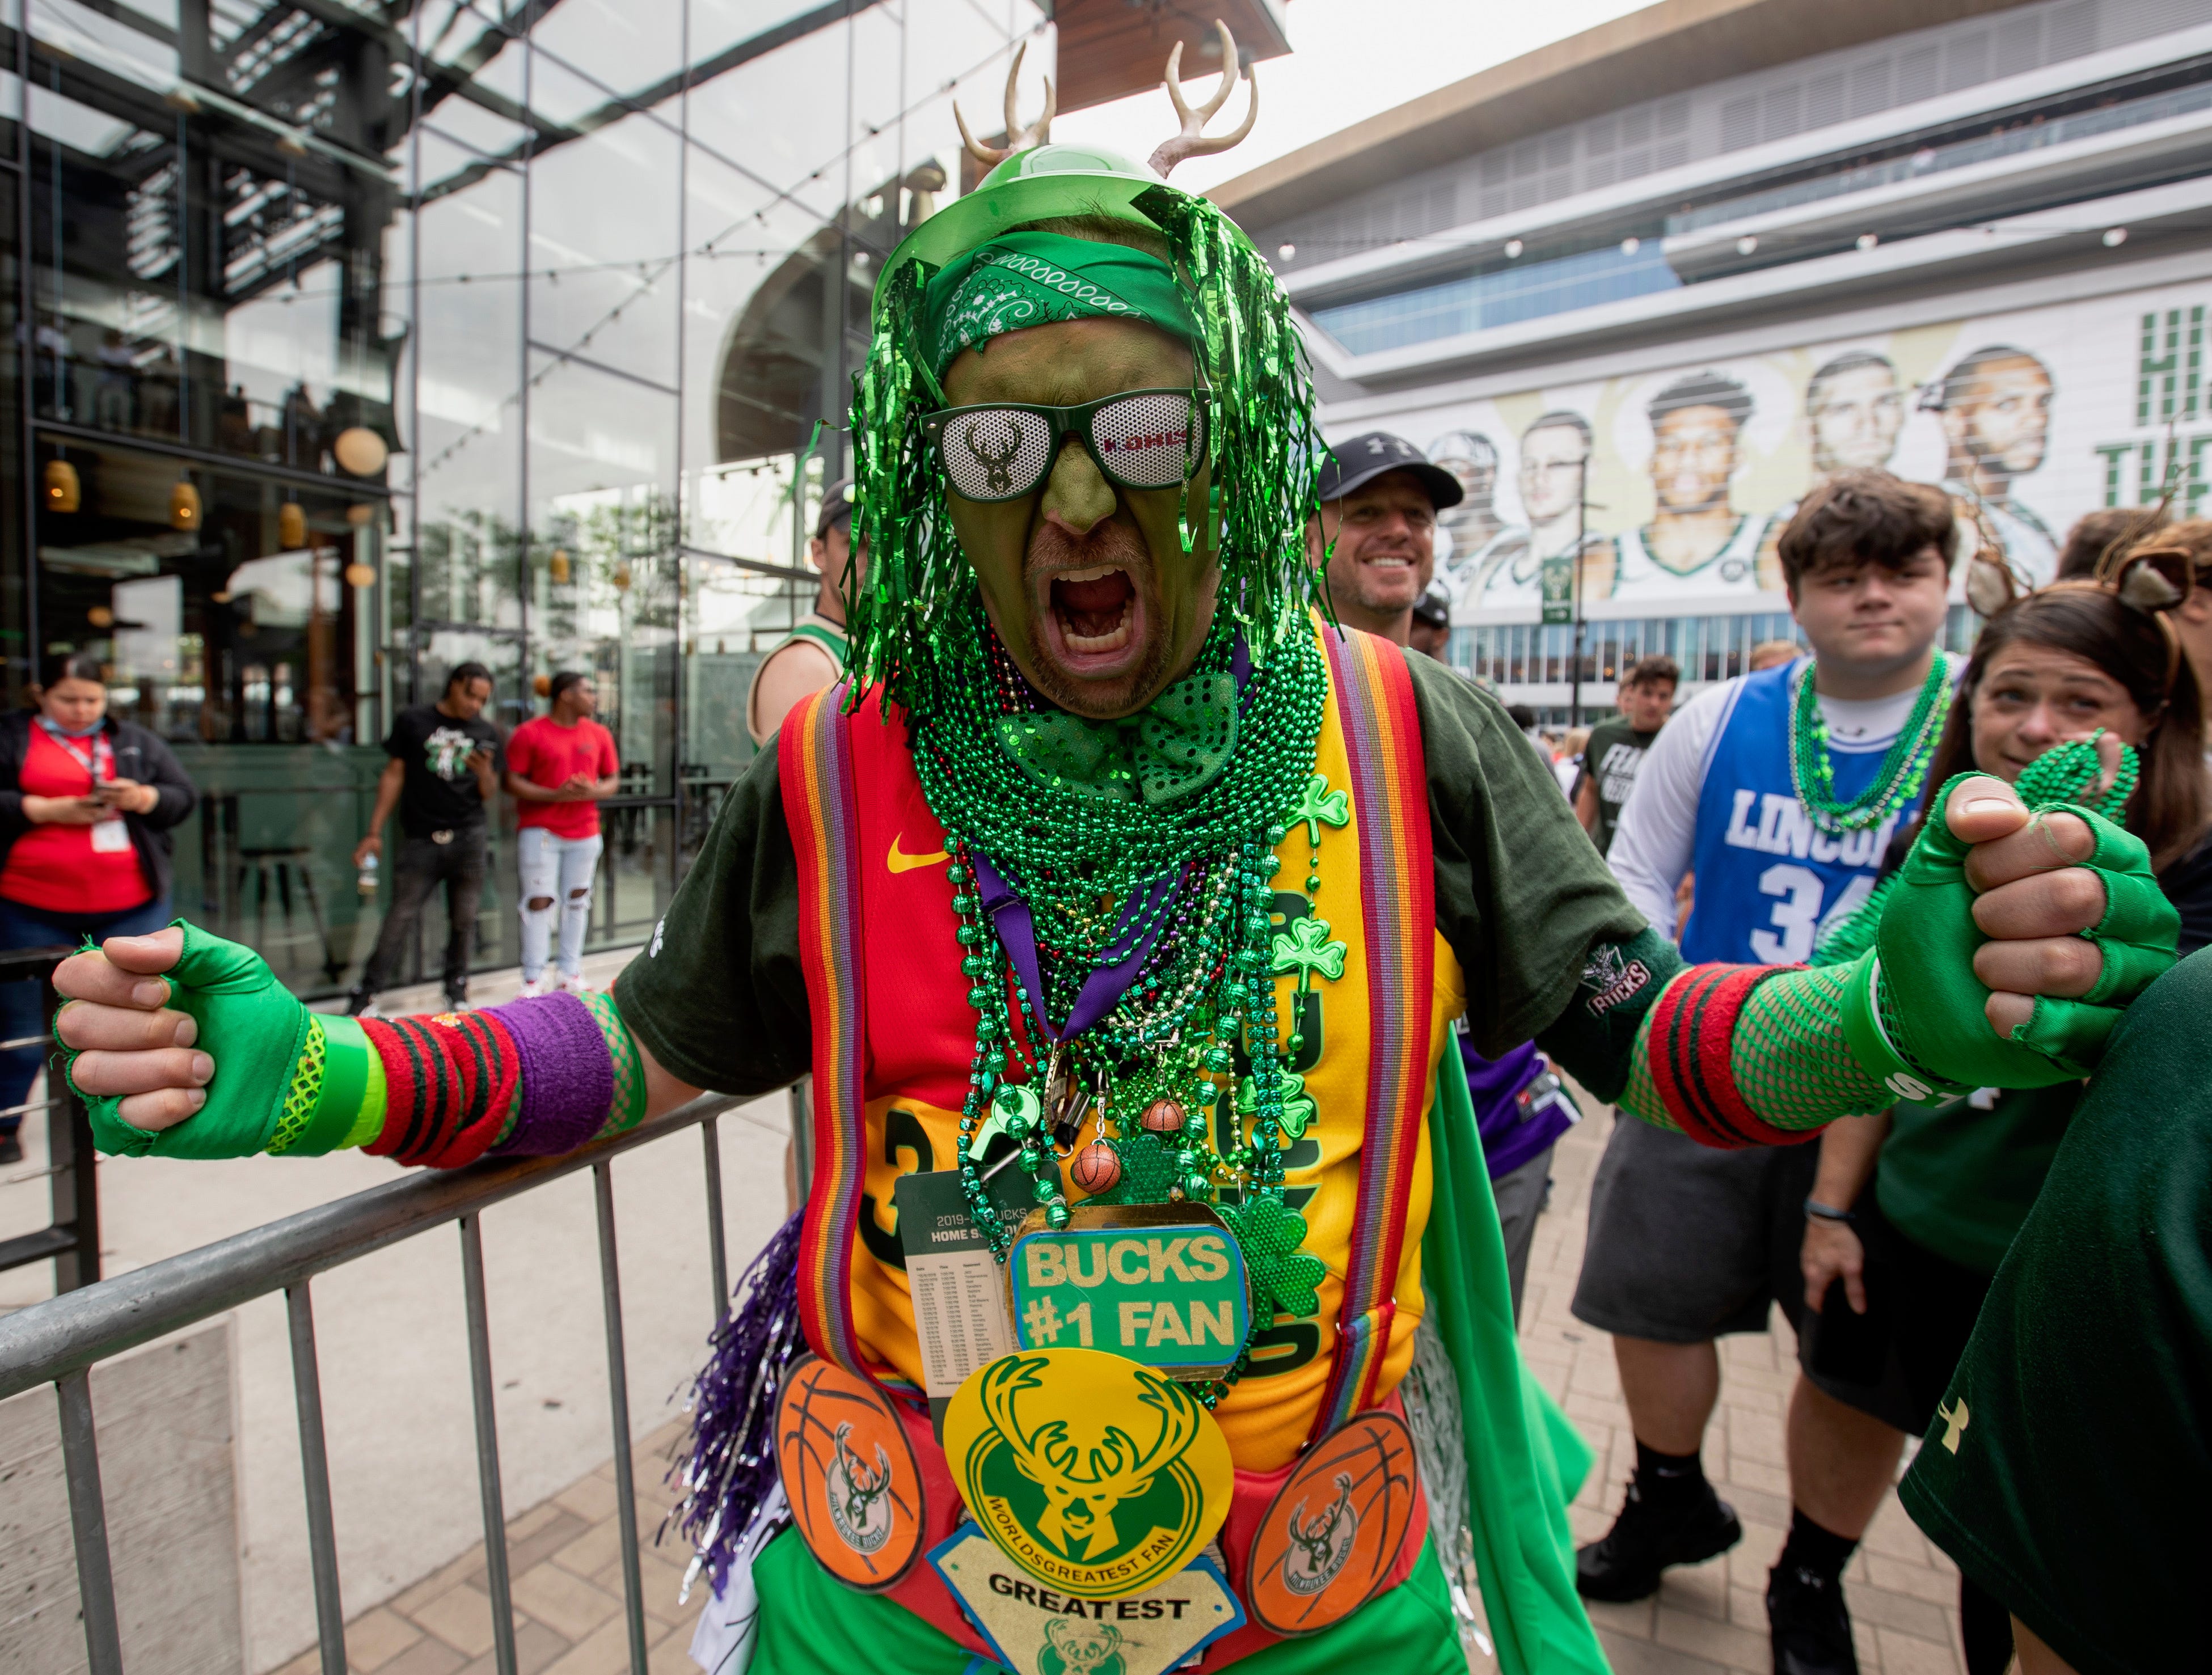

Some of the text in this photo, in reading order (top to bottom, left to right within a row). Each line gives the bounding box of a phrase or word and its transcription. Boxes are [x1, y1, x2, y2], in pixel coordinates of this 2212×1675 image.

[2138, 304, 2212, 426] HI
[1725, 789, 1920, 868] LINCO
[931, 1229, 969, 1243] HOME
[937, 1213, 976, 1227] 2019-
[1025, 1236, 1230, 1288] BUCKS
[1023, 1296, 1095, 1348] #1
[1118, 1301, 1234, 1347] FAN
[1141, 1533, 1175, 1562] FAN
[989, 1574, 1191, 1620] GREATEST
